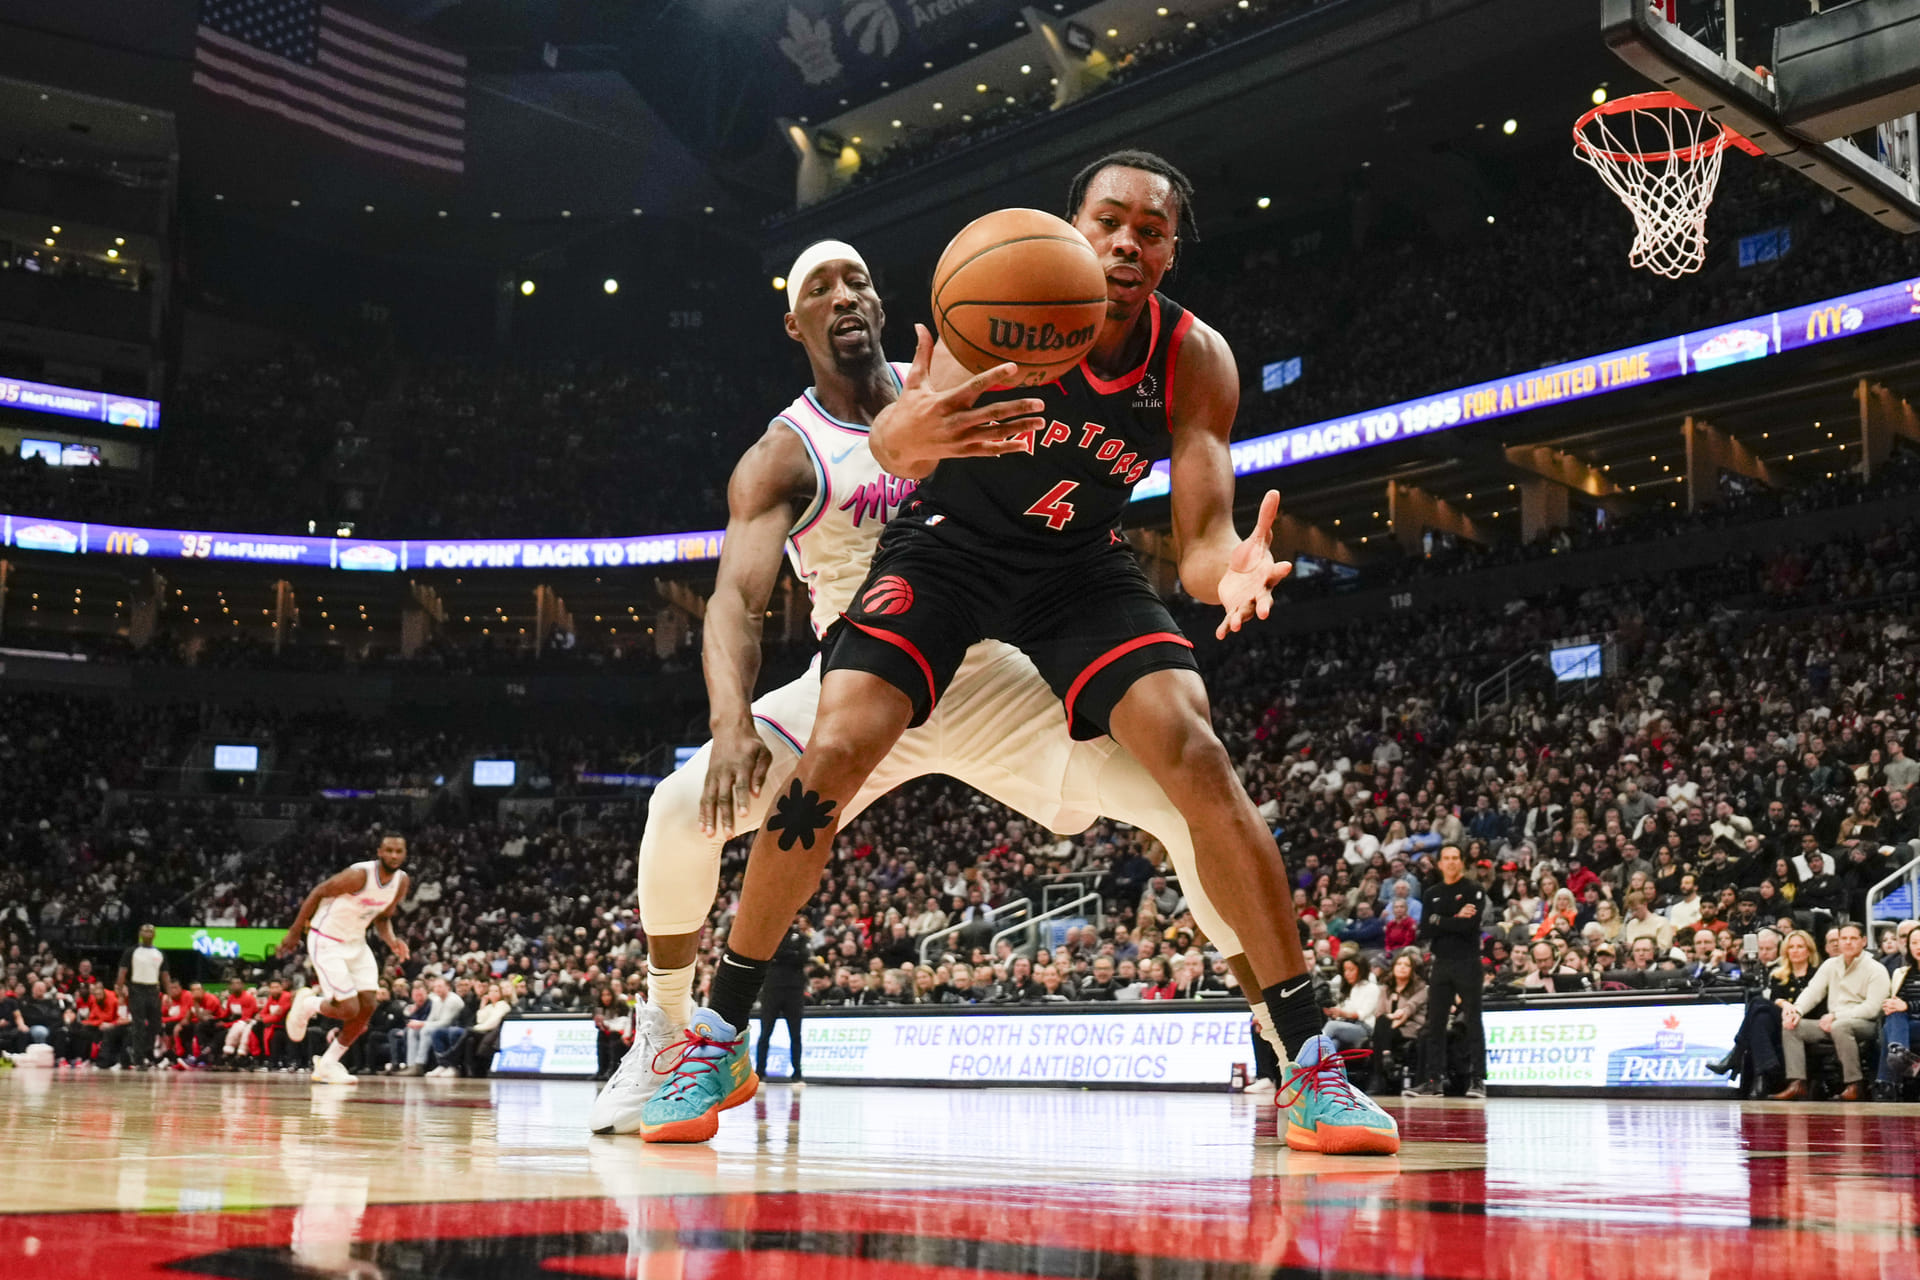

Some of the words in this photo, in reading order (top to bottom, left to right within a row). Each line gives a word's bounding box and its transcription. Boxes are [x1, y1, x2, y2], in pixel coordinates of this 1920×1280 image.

[989, 317, 1095, 351] Wilson
[1145, 398, 1164, 408] Life
[1291, 425, 1360, 460] BACK
[1361, 412, 1400, 441] TO
[1402, 397, 1461, 433] 1995
[1463, 390, 1499, 419] FOR
[1500, 386, 1515, 411] A
[1517, 366, 1597, 407] LIMITED
[1601, 352, 1650, 386] TIME
[1023, 479, 1080, 531] 4
[425, 544, 520, 567] POPPIN'
[522, 544, 590, 567] BACK
[589, 545, 624, 566] TO
[626, 540, 676, 565] 1995
[677, 538, 706, 560] FOR
[707, 537, 718, 557] A
[807, 1027, 871, 1042] RAISED
[894, 1025, 943, 1045] TRUE
[948, 1024, 1022, 1045] NORTH
[1028, 1023, 1124, 1047] STRONG
[1131, 1023, 1183, 1046] AND
[1192, 1021, 1252, 1046] FREE
[1489, 1024, 1597, 1043] RAISED
[802, 1045, 869, 1059] WITHOUT
[1487, 1046, 1595, 1064] WITHOUT
[949, 1055, 1013, 1077] FROM
[1018, 1054, 1168, 1079] ANTIBIOTICS
[1486, 1066, 1593, 1081] antibiotics
